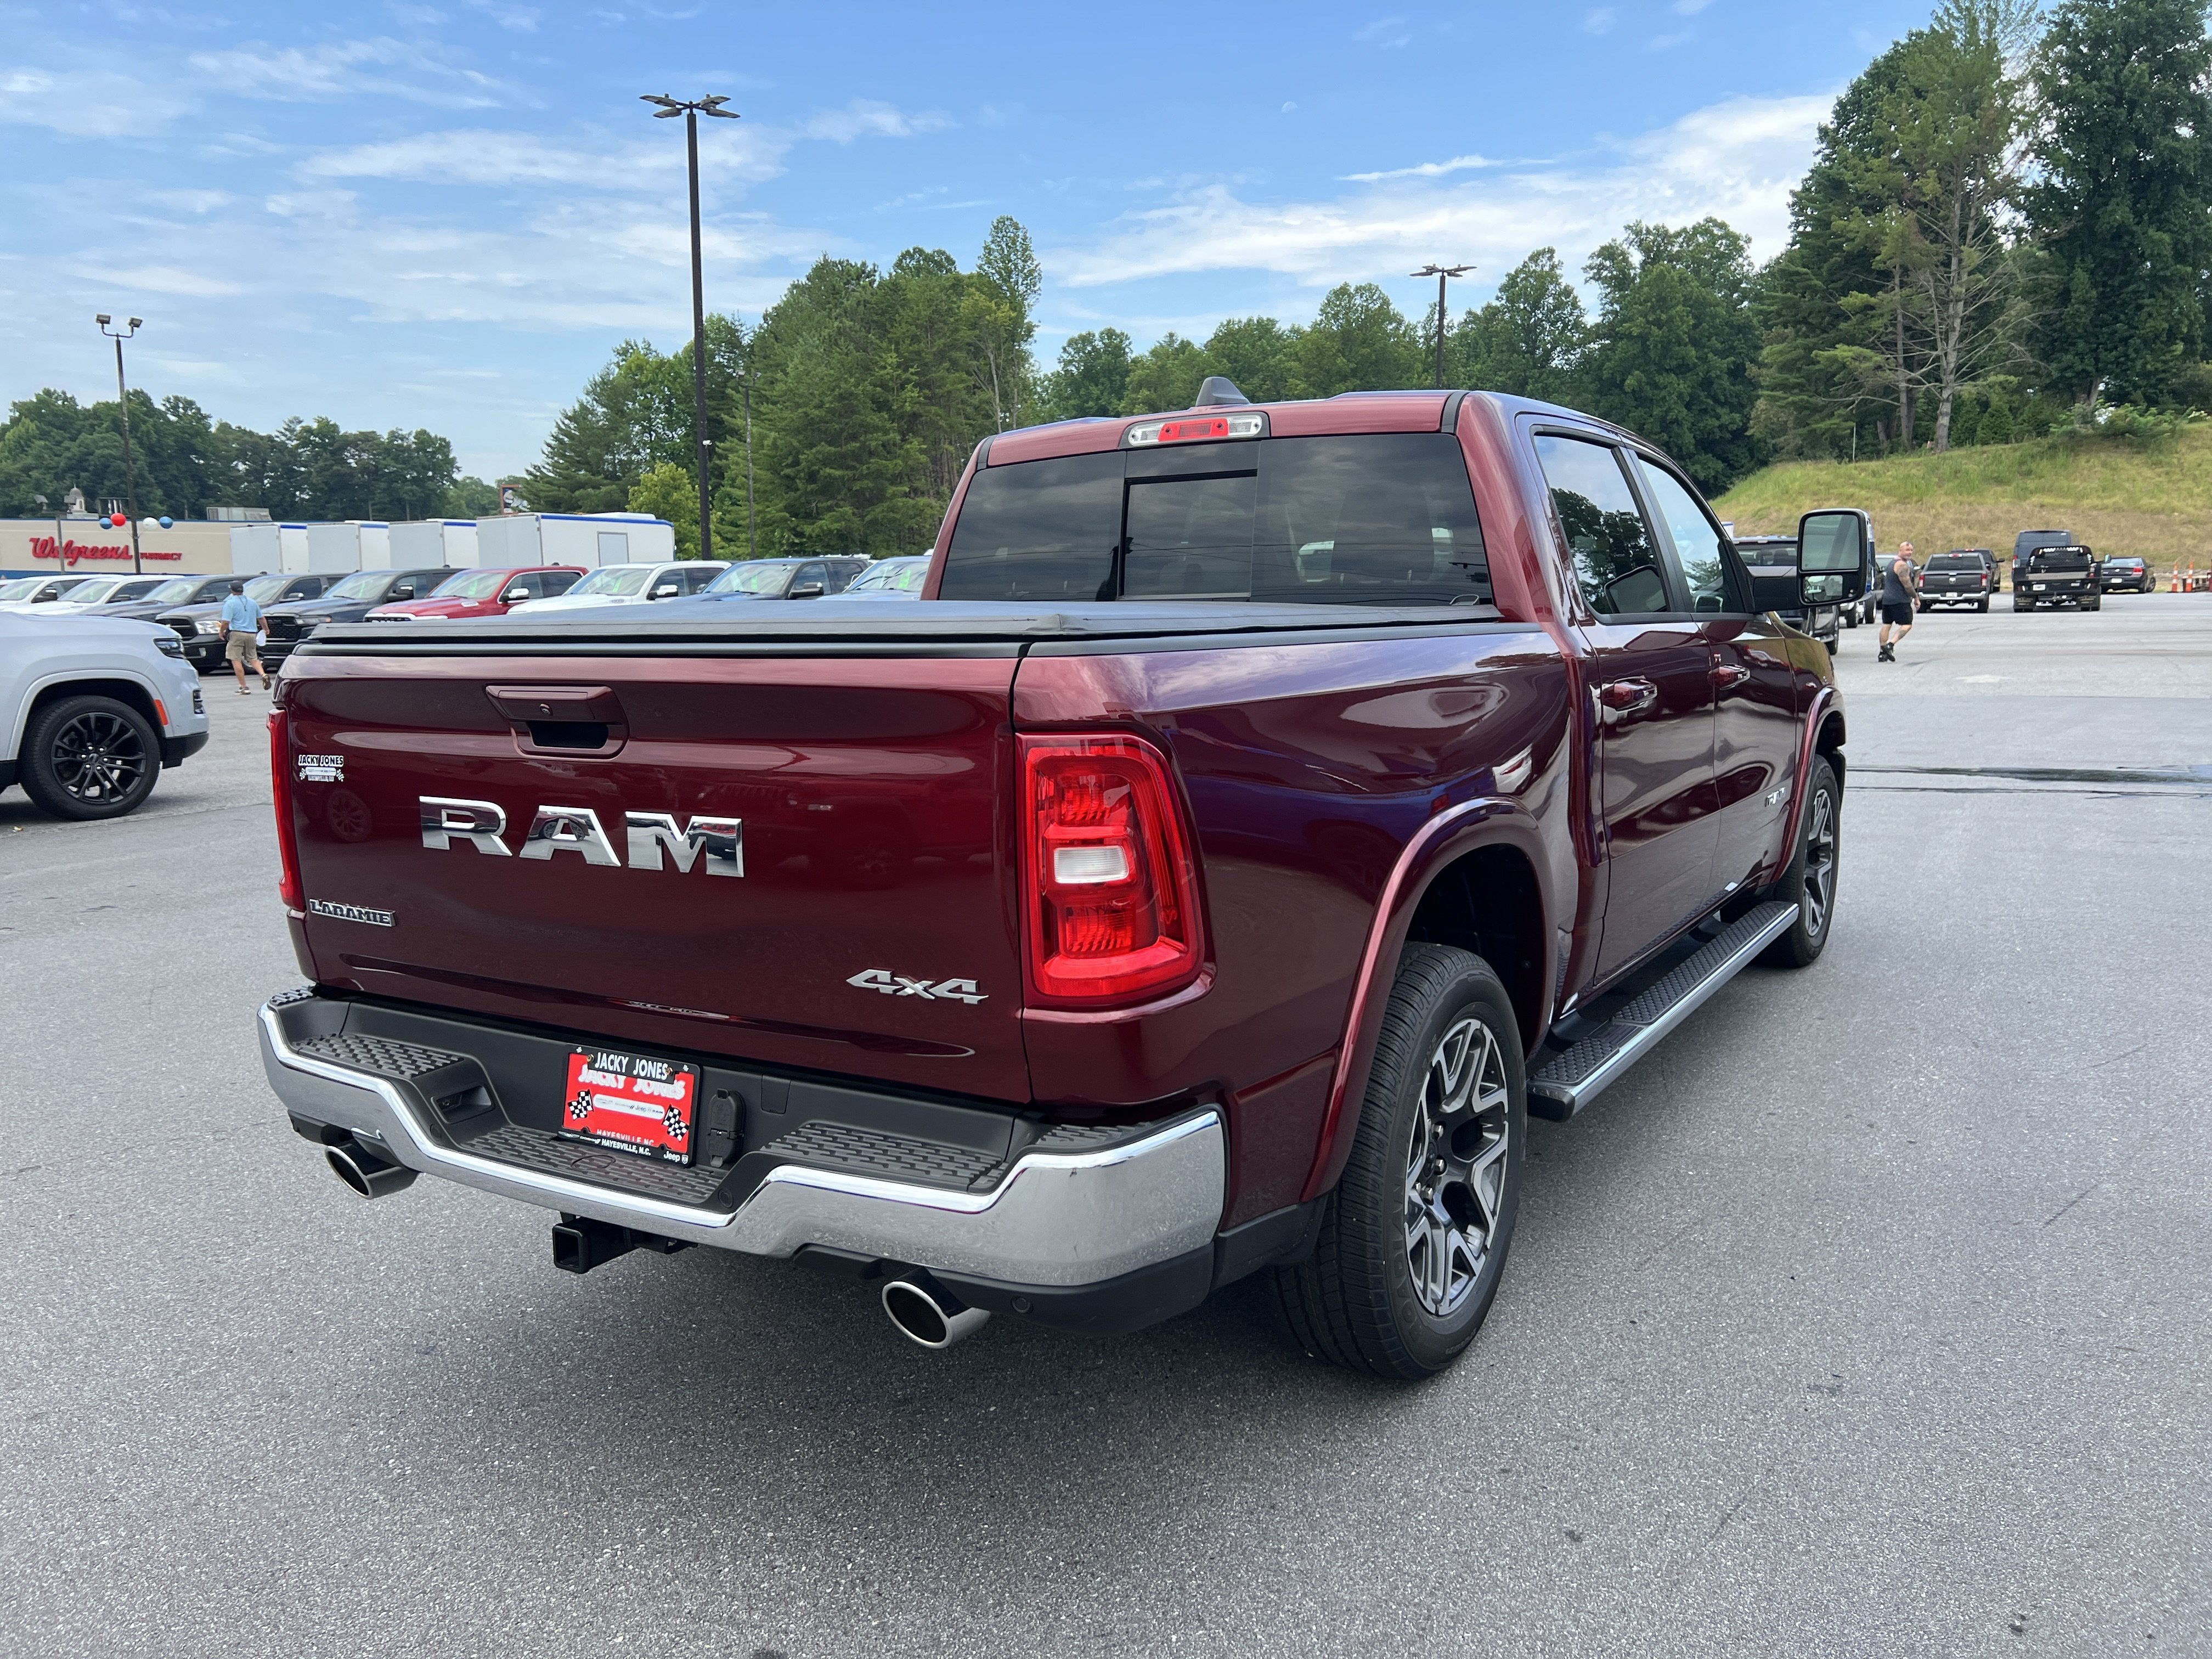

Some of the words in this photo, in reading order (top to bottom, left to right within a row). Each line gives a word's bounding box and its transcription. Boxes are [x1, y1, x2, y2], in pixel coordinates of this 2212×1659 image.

[29, 536, 133, 566] Walgreens
[299, 755, 319, 765] JACKY
[320, 755, 344, 766] JONES
[419, 795, 744, 878] RAM
[309, 899, 396, 927] LARAMIE
[594, 1052, 629, 1073] JACKY
[633, 1058, 668, 1080] JONES
[601, 1138, 638, 1154] HAYESVILLE,
[663, 1150, 680, 1163] Jeep
